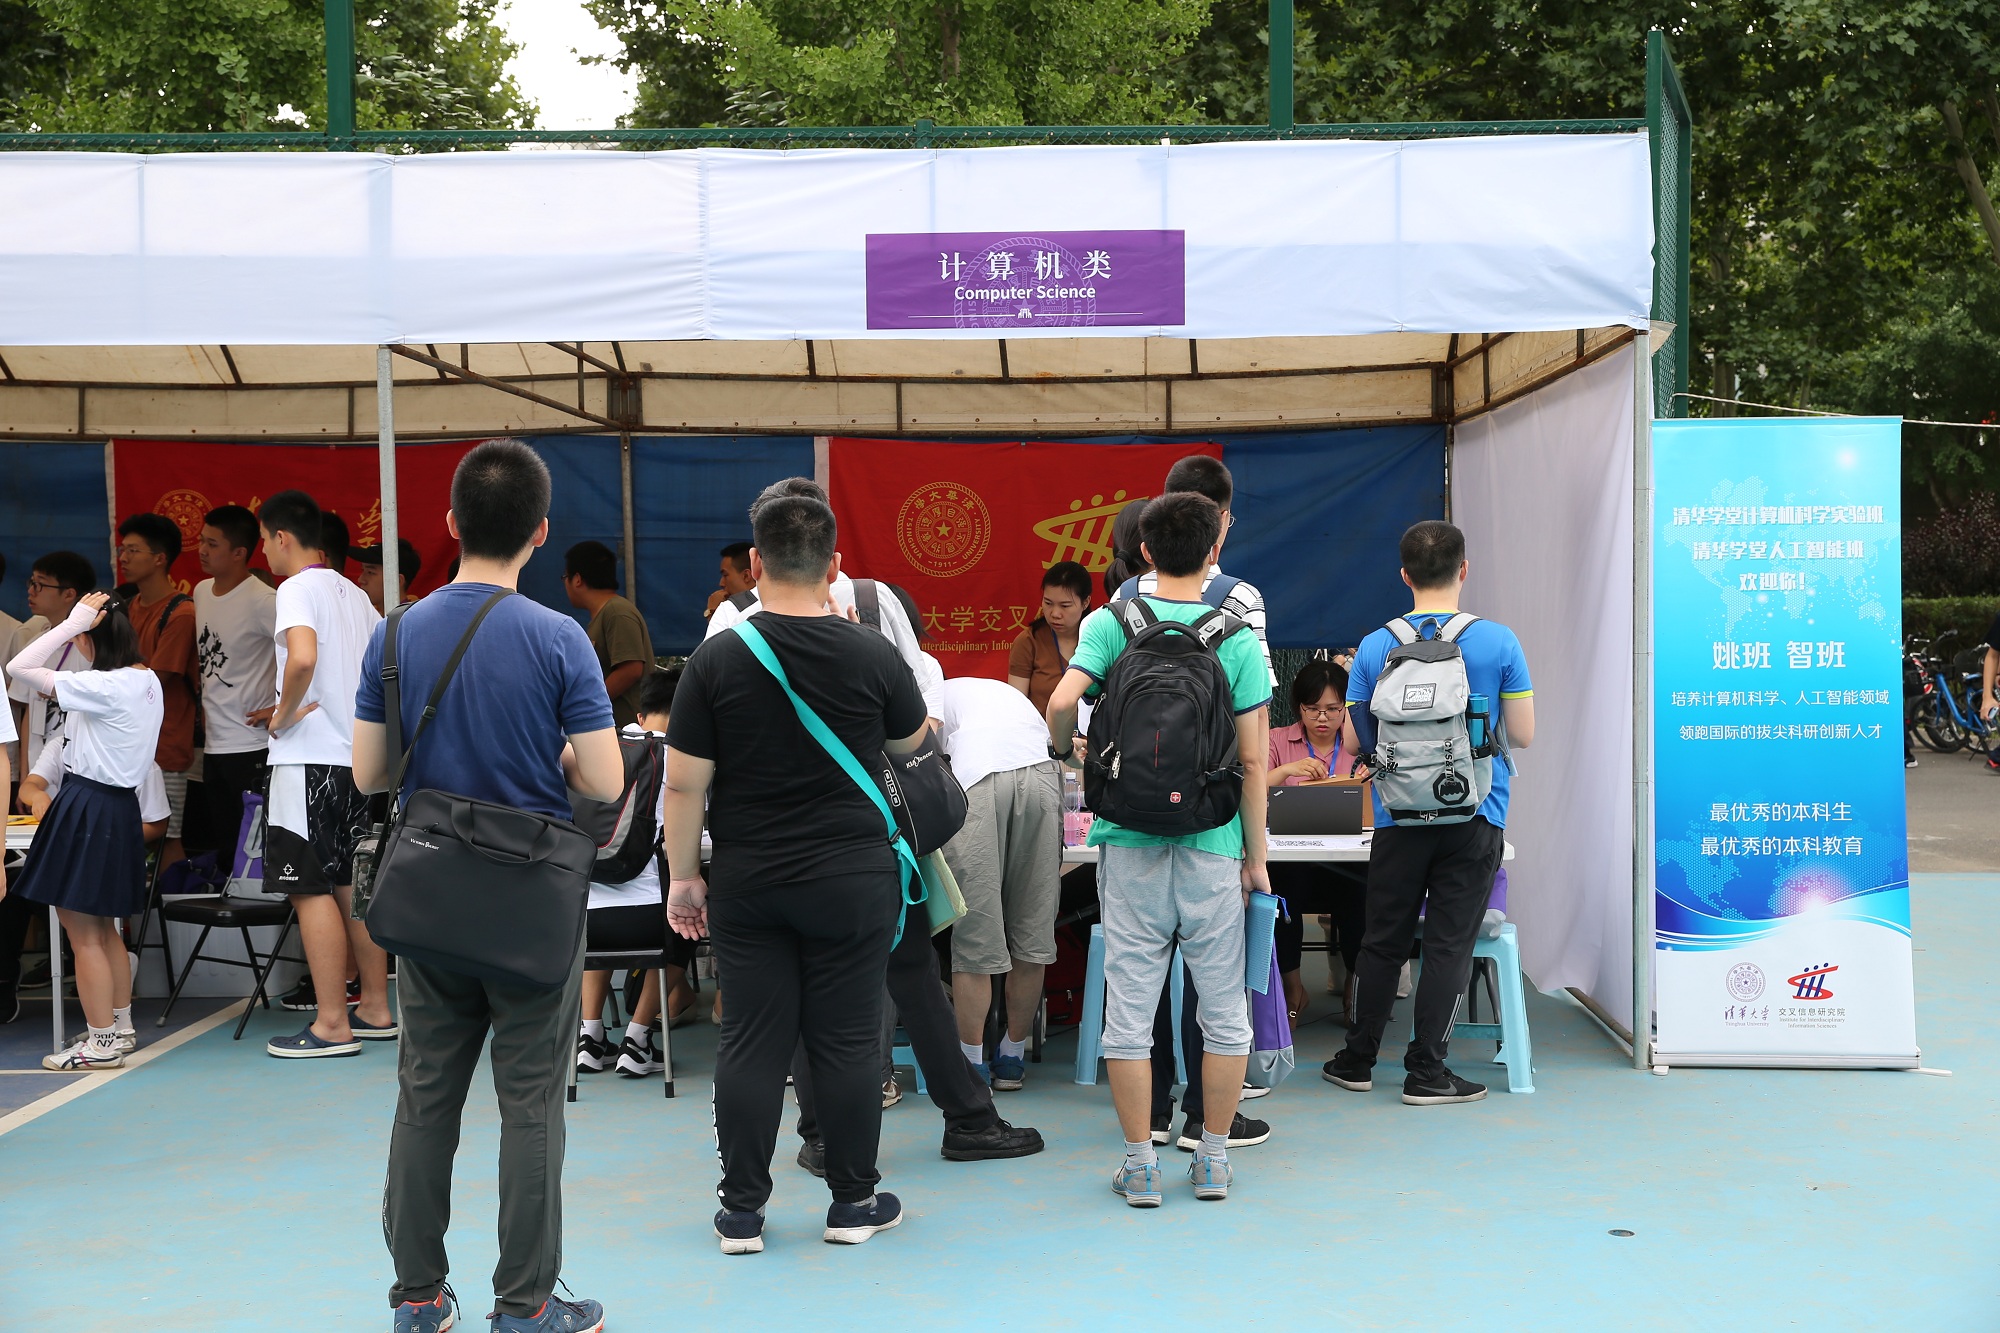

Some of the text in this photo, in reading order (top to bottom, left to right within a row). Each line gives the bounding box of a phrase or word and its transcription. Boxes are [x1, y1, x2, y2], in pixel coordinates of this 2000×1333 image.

[938, 250, 1112, 281] 计算机类
[955, 285, 1096, 302] Computer Science
[1673, 505, 1884, 526] 清华学堂计算机科学实验班
[906, 517, 923, 559] TSINGHUA
[962, 518, 982, 560] UNIVERSITY
[1693, 540, 1864, 560] 清华学堂人工智能班
[1739, 572, 1806, 591] 欢迎你！
[922, 605, 1043, 633] 大学交叉
[919, 640, 989, 653] nterdisciplinary
[1712, 640, 1846, 670] 姚班 智班
[1671, 689, 1890, 707] 培养计算机科学、人工智能领域
[1679, 723, 1883, 741] 领跑国际的拔尖科研创新人才
[1709, 802, 1853, 823] 最优秀的本科生
[1700, 835, 1864, 856] 最优秀的本科教育
[1778, 1007, 1846, 1016] 交叉信息研究院
